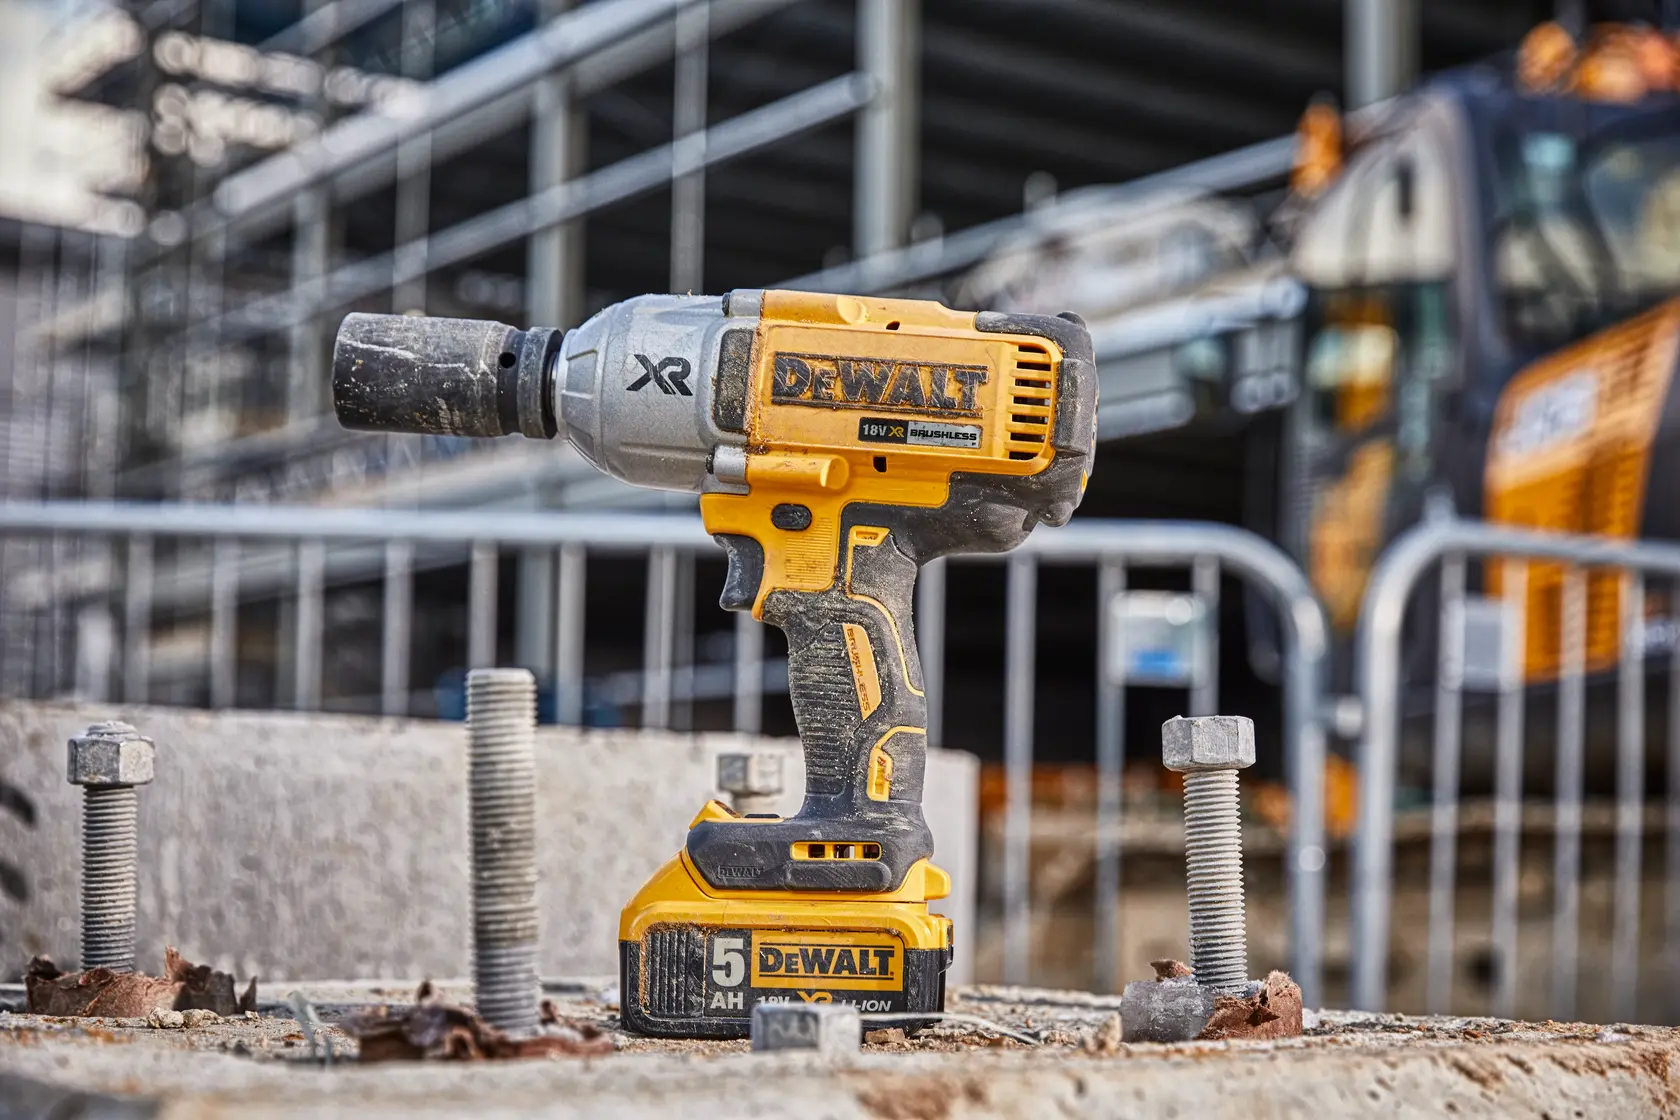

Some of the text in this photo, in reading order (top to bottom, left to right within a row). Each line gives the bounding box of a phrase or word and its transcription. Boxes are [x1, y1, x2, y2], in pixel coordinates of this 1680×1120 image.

[626, 354, 693, 396] XR
[862, 423, 977, 441] 18V XR BRUSHLESS
[712, 937, 745, 987] 5
[710, 991, 744, 1010] AH
